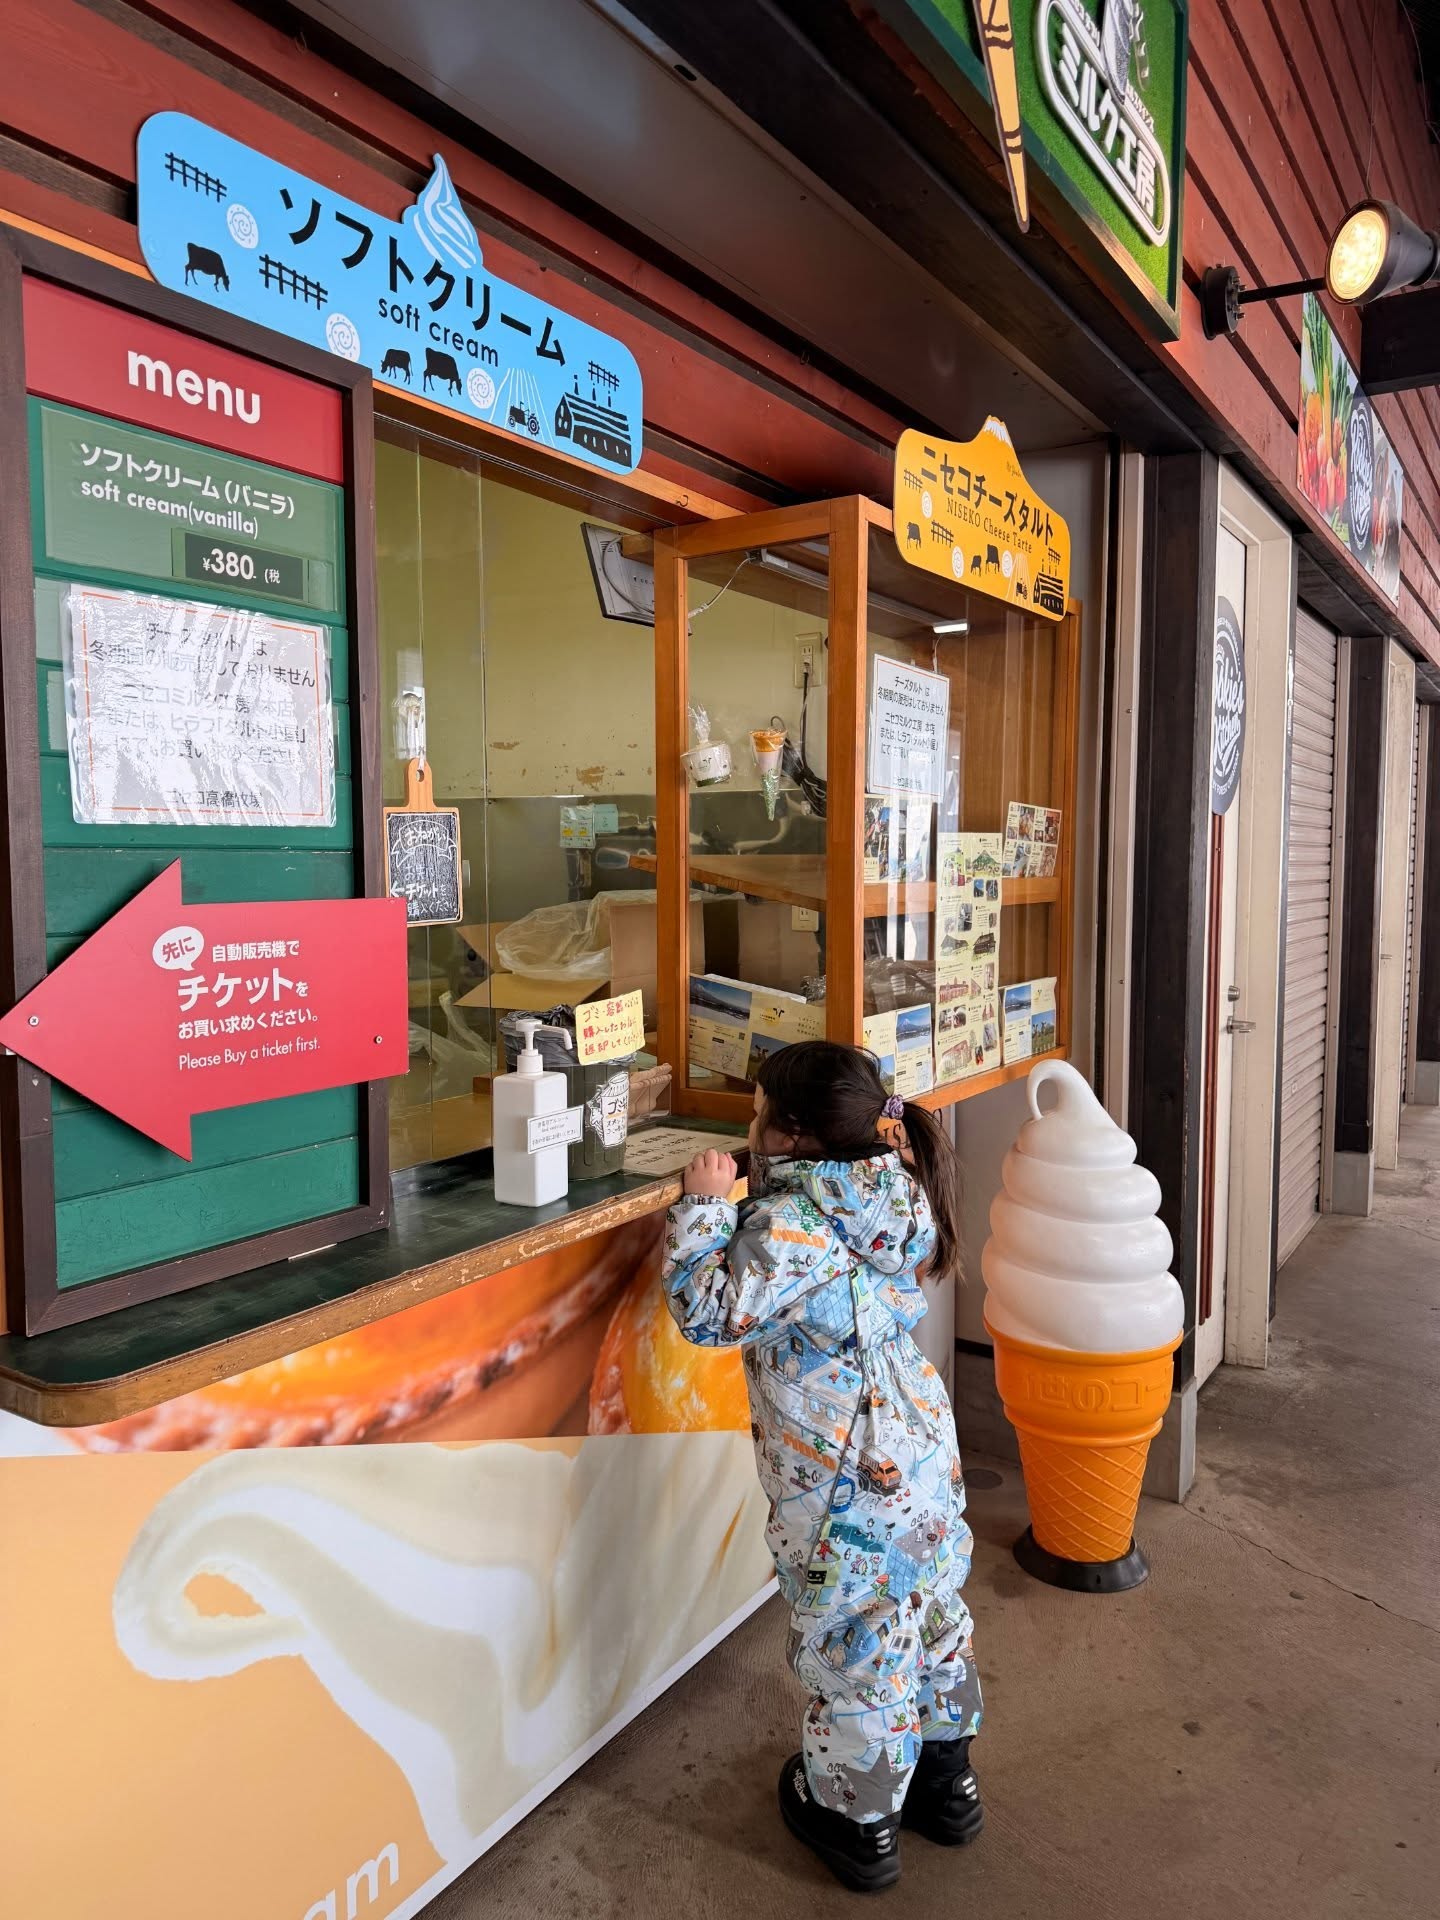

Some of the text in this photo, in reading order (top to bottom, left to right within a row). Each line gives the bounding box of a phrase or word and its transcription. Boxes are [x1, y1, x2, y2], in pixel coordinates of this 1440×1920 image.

[1058, 22, 1156, 218] ミルク工房
[279, 187, 567, 367] ソフトクリーム
[378, 297, 500, 369] soft cream
[127, 350, 261, 424] menu
[81, 478, 259, 540] soft cream(vanilla)
[921, 446, 1054, 546] ニセコチーズタルト
[946, 497, 1032, 554] NISEKO Cheese Tarte
[404, 826, 447, 846] おねがい
[162, 936, 300, 963] 先に 自動販売機で
[177, 968, 309, 1012] チケットを
[178, 1008, 319, 1040] お買い求めください。
[179, 1036, 321, 1071] Please Buy a ticket first.
